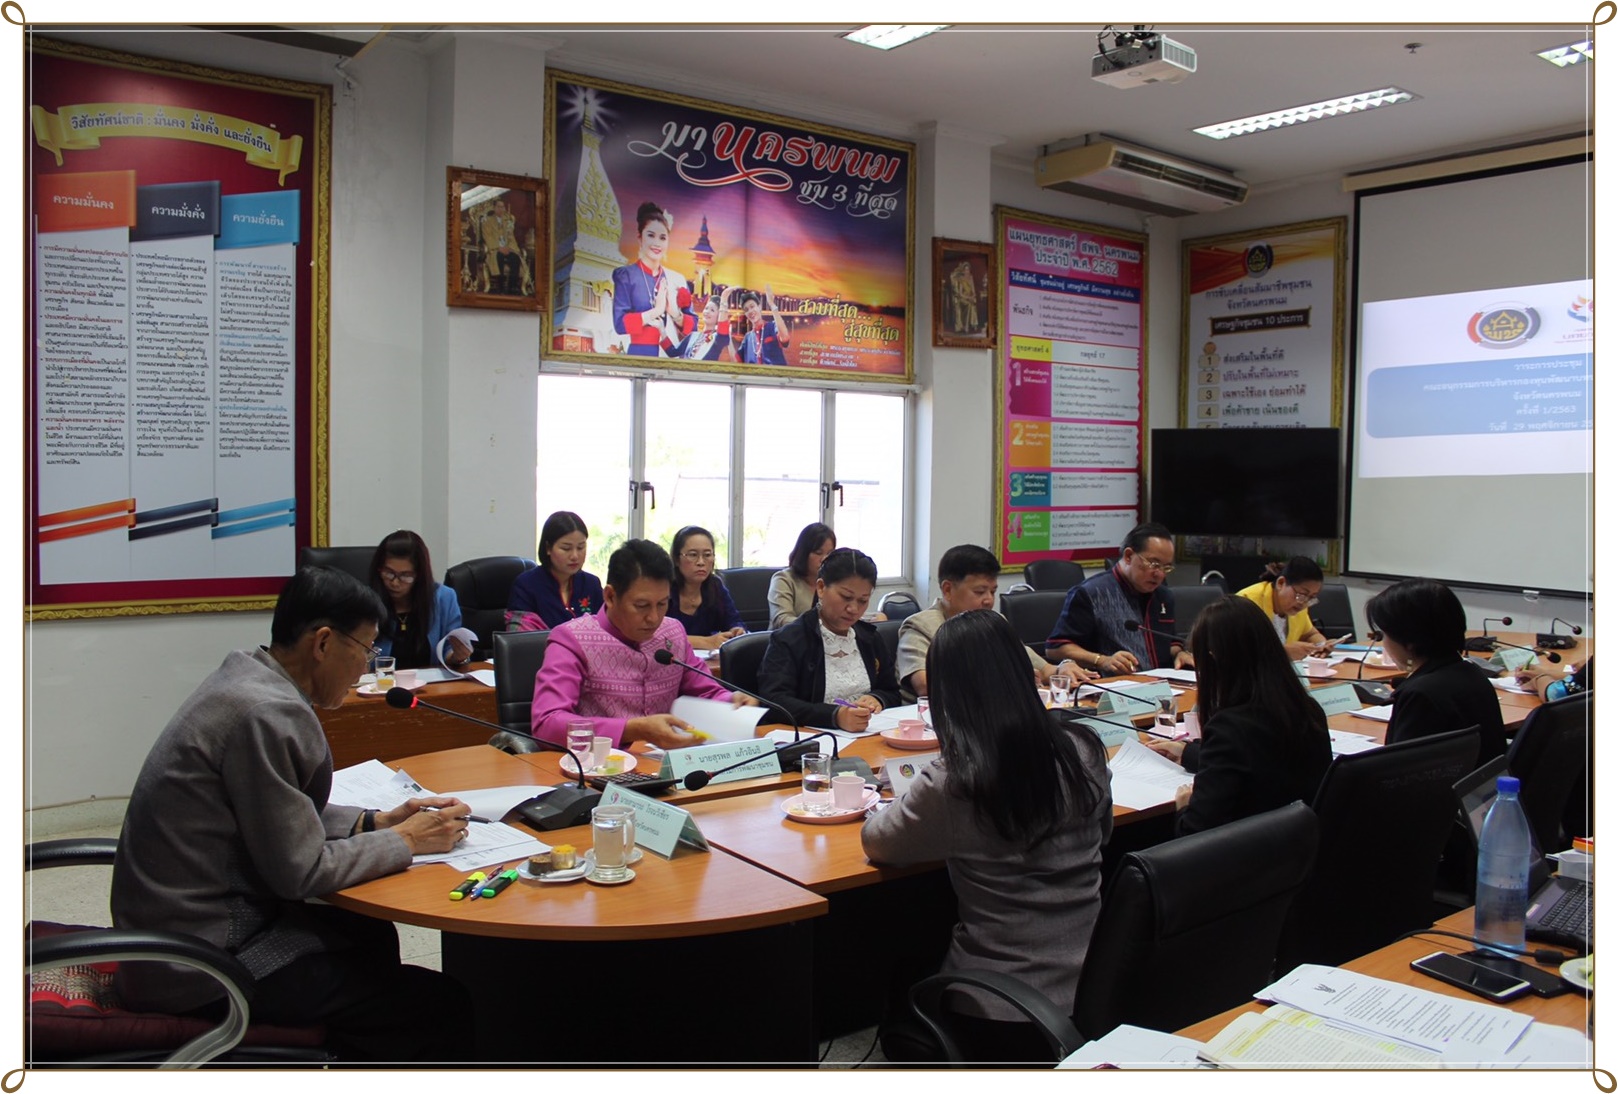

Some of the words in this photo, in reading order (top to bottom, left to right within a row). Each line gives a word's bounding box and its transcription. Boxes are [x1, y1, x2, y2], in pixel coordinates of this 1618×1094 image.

[71, 112, 144, 130] วิสัยทัศน์ชาติ
[153, 109, 185, 129] มั่นคง
[190, 116, 219, 135] มั่งคั่ง
[223, 127, 272, 153] และยั่งยืน
[676, 122, 901, 192] นครพนม
[53, 191, 114, 210] ความมั่นคง
[796, 175, 836, 210] ชม
[832, 184, 847, 201] 3
[846, 182, 903, 219] ที่สุด
[151, 201, 205, 220] ความมั่งคั่ง
[232, 210, 284, 227] ความยั่งยืน
[1009, 228, 1076, 249] แผนยุทธศาสตร์
[1082, 240, 1101, 255] สพจ.
[1104, 246, 1140, 261] นครพนม
[1036, 250, 1070, 266] ประจำปี
[1072, 258, 1090, 270] พ.ศ.
[1093, 260, 1118, 276] 2562
[1205, 278, 1312, 298] การขับเคลื่อนสัมมาชีพชุมชน
[1012, 304, 1033, 316] พันธกิจ
[1227, 296, 1287, 310] จังหวัดนครพนม
[1215, 317, 1263, 331] เศรษฐกิจชุมชน
[1266, 315, 1275, 324] 10
[1276, 313, 1303, 324] ประการ
[1514, 359, 1582, 371] วาระการประชุม
[1513, 389, 1582, 401] จังหวัดนครพนม
[1012, 422, 1023, 445] 2
[1010, 474, 1023, 497] 3
